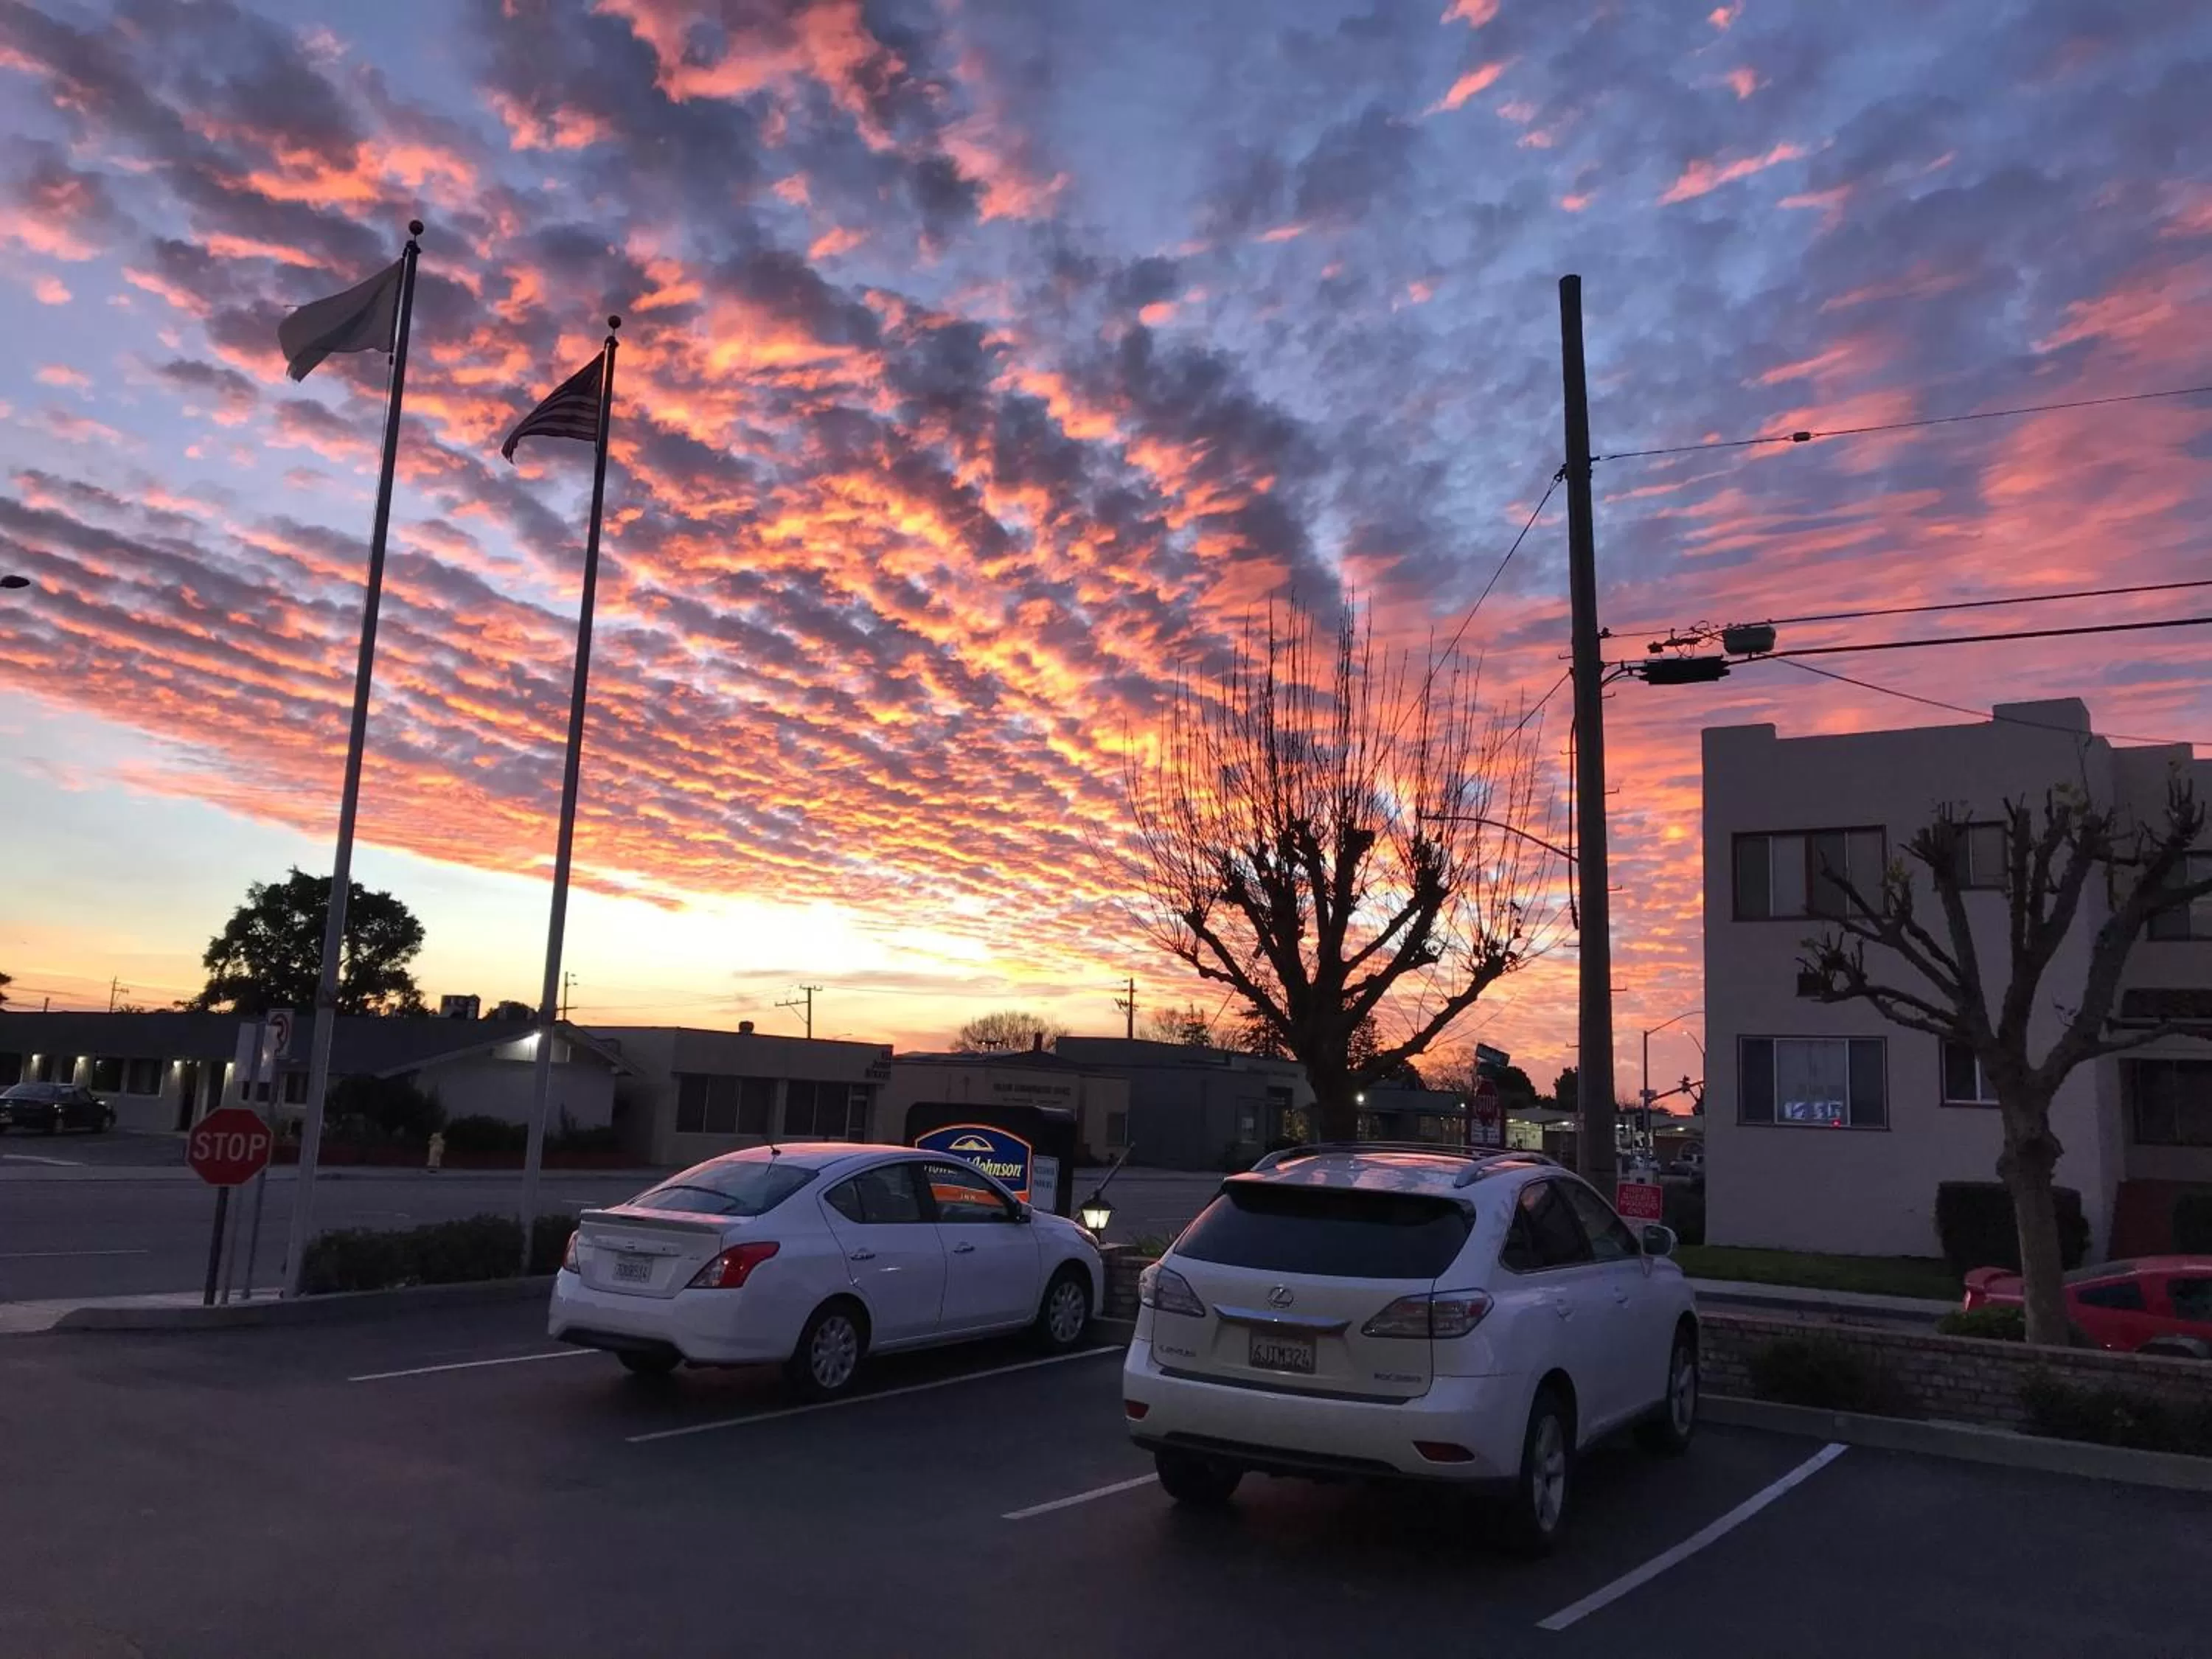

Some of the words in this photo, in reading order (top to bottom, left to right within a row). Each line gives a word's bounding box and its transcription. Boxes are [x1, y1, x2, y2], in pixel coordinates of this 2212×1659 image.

[1478, 1094, 1498, 1113] STOP
[192, 1132, 267, 1162] STOP
[973, 1155, 1023, 1178] Johnson
